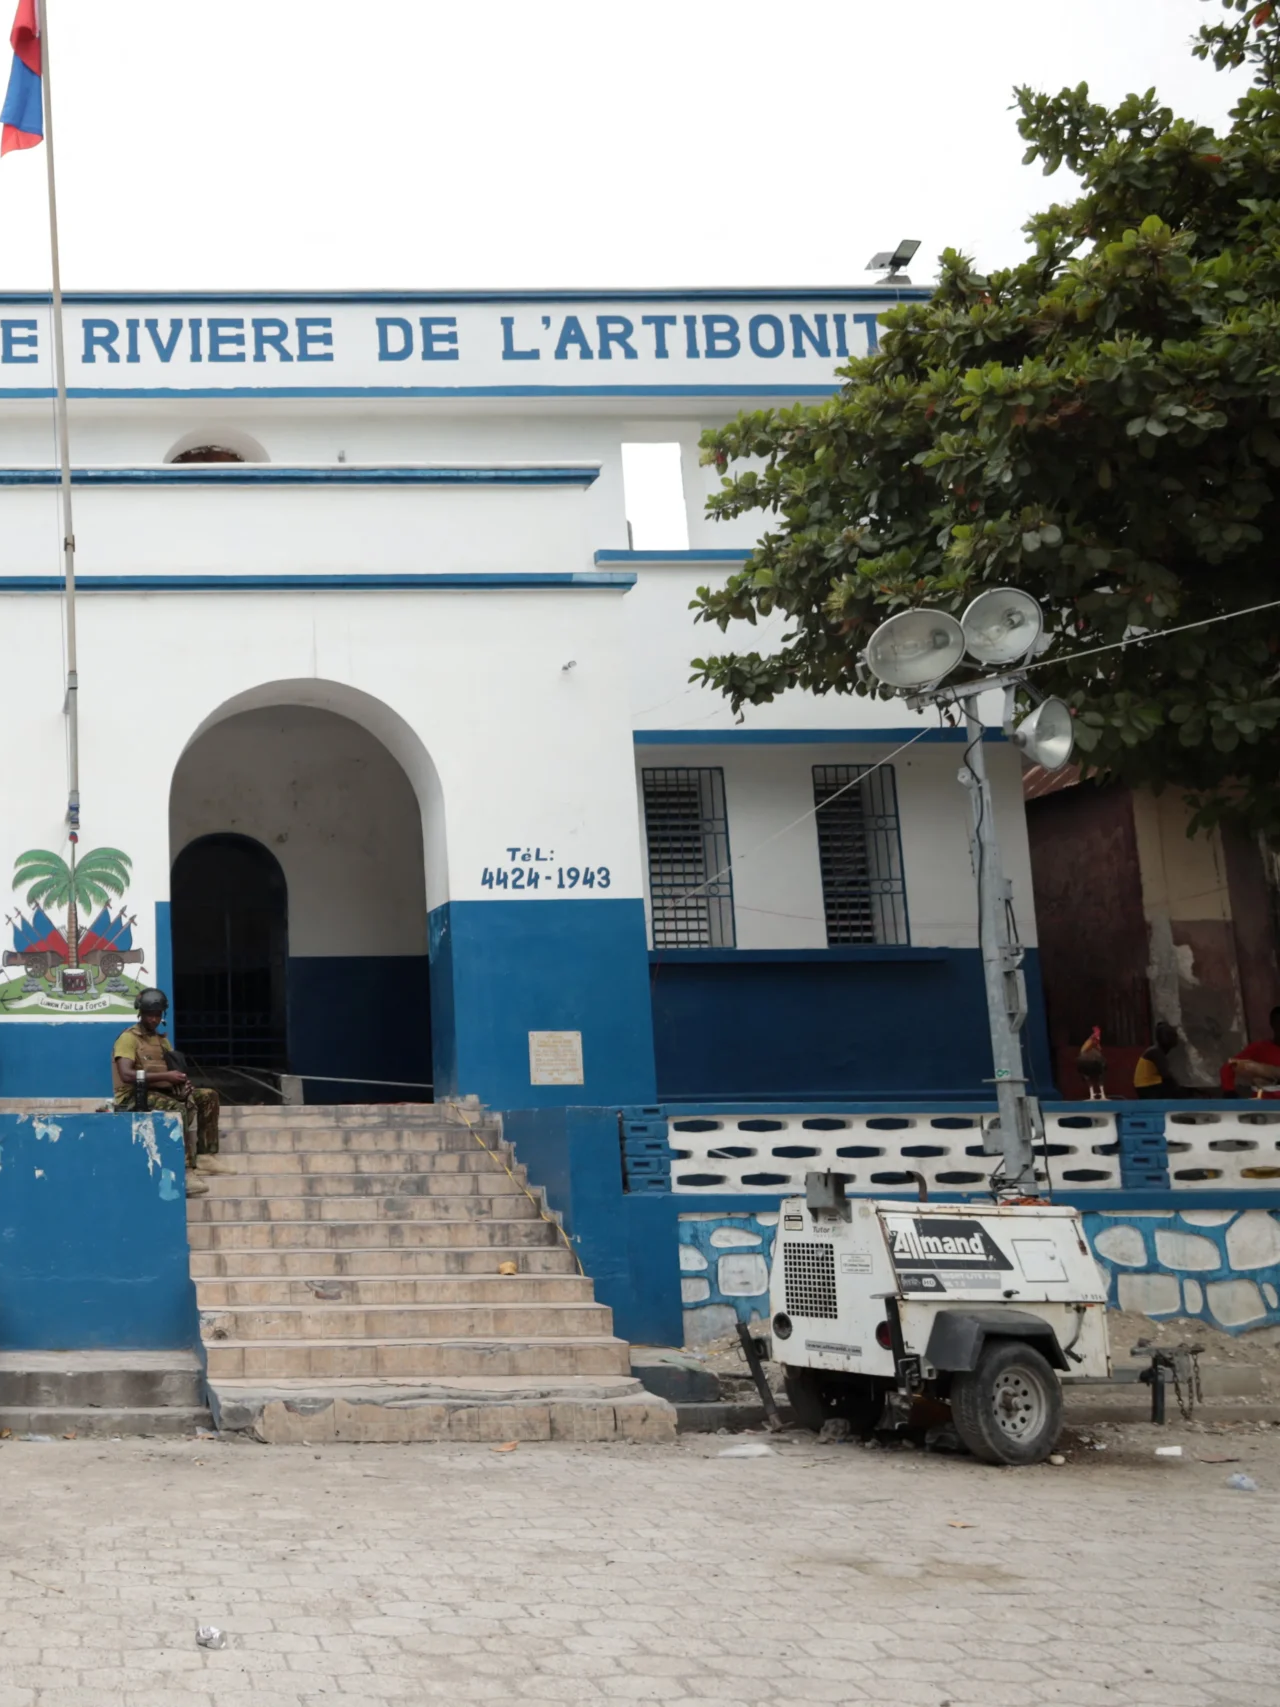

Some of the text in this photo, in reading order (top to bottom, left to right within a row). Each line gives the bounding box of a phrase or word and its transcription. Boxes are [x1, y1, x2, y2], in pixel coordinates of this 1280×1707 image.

[81, 317, 335, 364] RIVIERE
[375, 316, 460, 362] DE
[500, 312, 880, 361] L'ARTIBONIT
[480, 866, 611, 890] 4424-1943
[893, 1231, 986, 1260] Allmand
